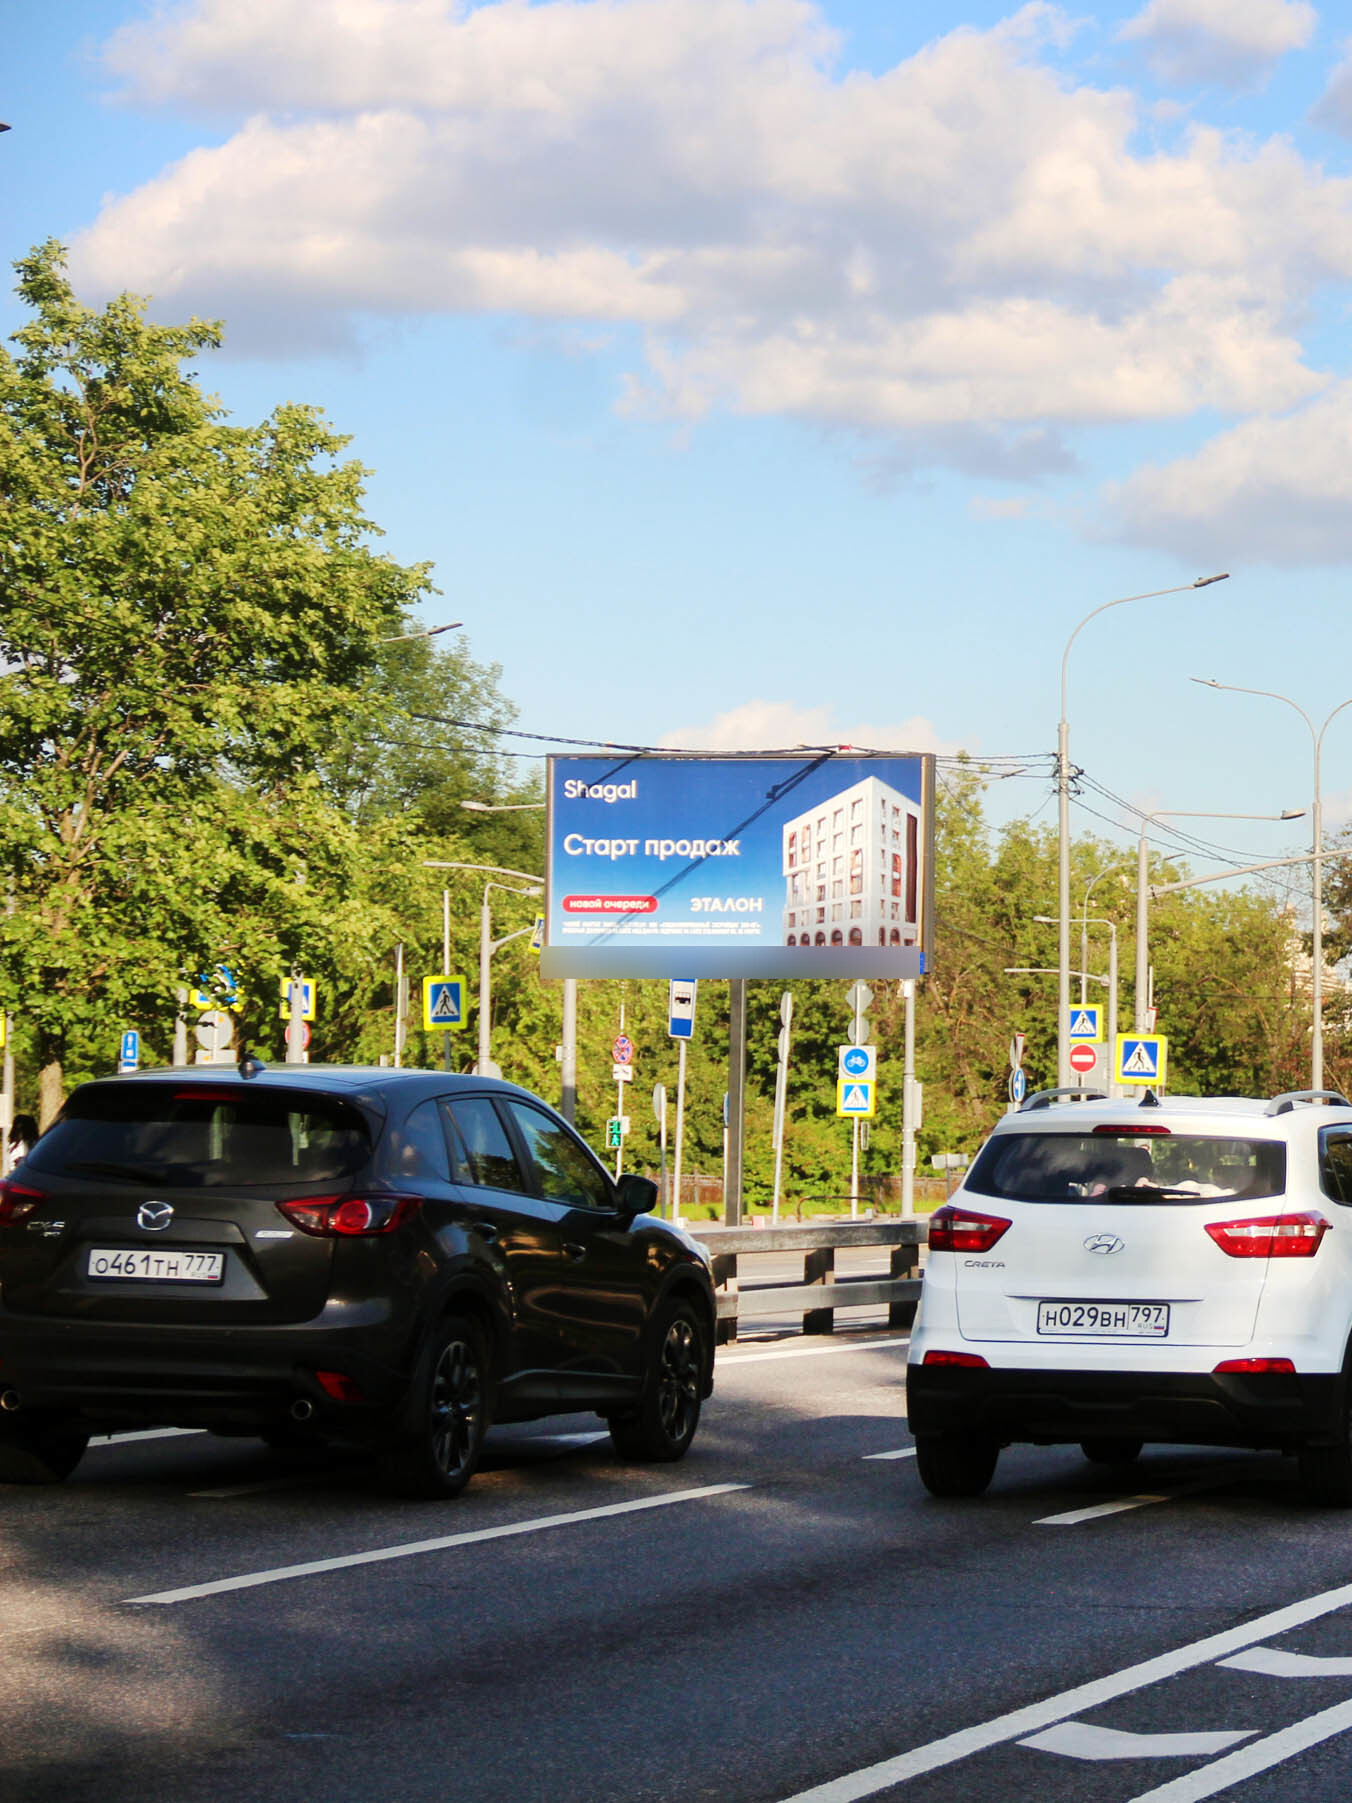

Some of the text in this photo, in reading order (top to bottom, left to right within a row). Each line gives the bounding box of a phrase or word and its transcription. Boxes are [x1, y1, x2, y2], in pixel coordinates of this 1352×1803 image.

[564, 779, 637, 803] Shagal
[563, 833, 740, 861] Старт продаж
[569, 898, 650, 911] новой очереди
[690, 897, 763, 912] ЭТАЛОН
[184, 1254, 217, 1272] 777
[964, 1260, 1005, 1268] CRETA
[1045, 1306, 1162, 1328] Н029ВН 797
